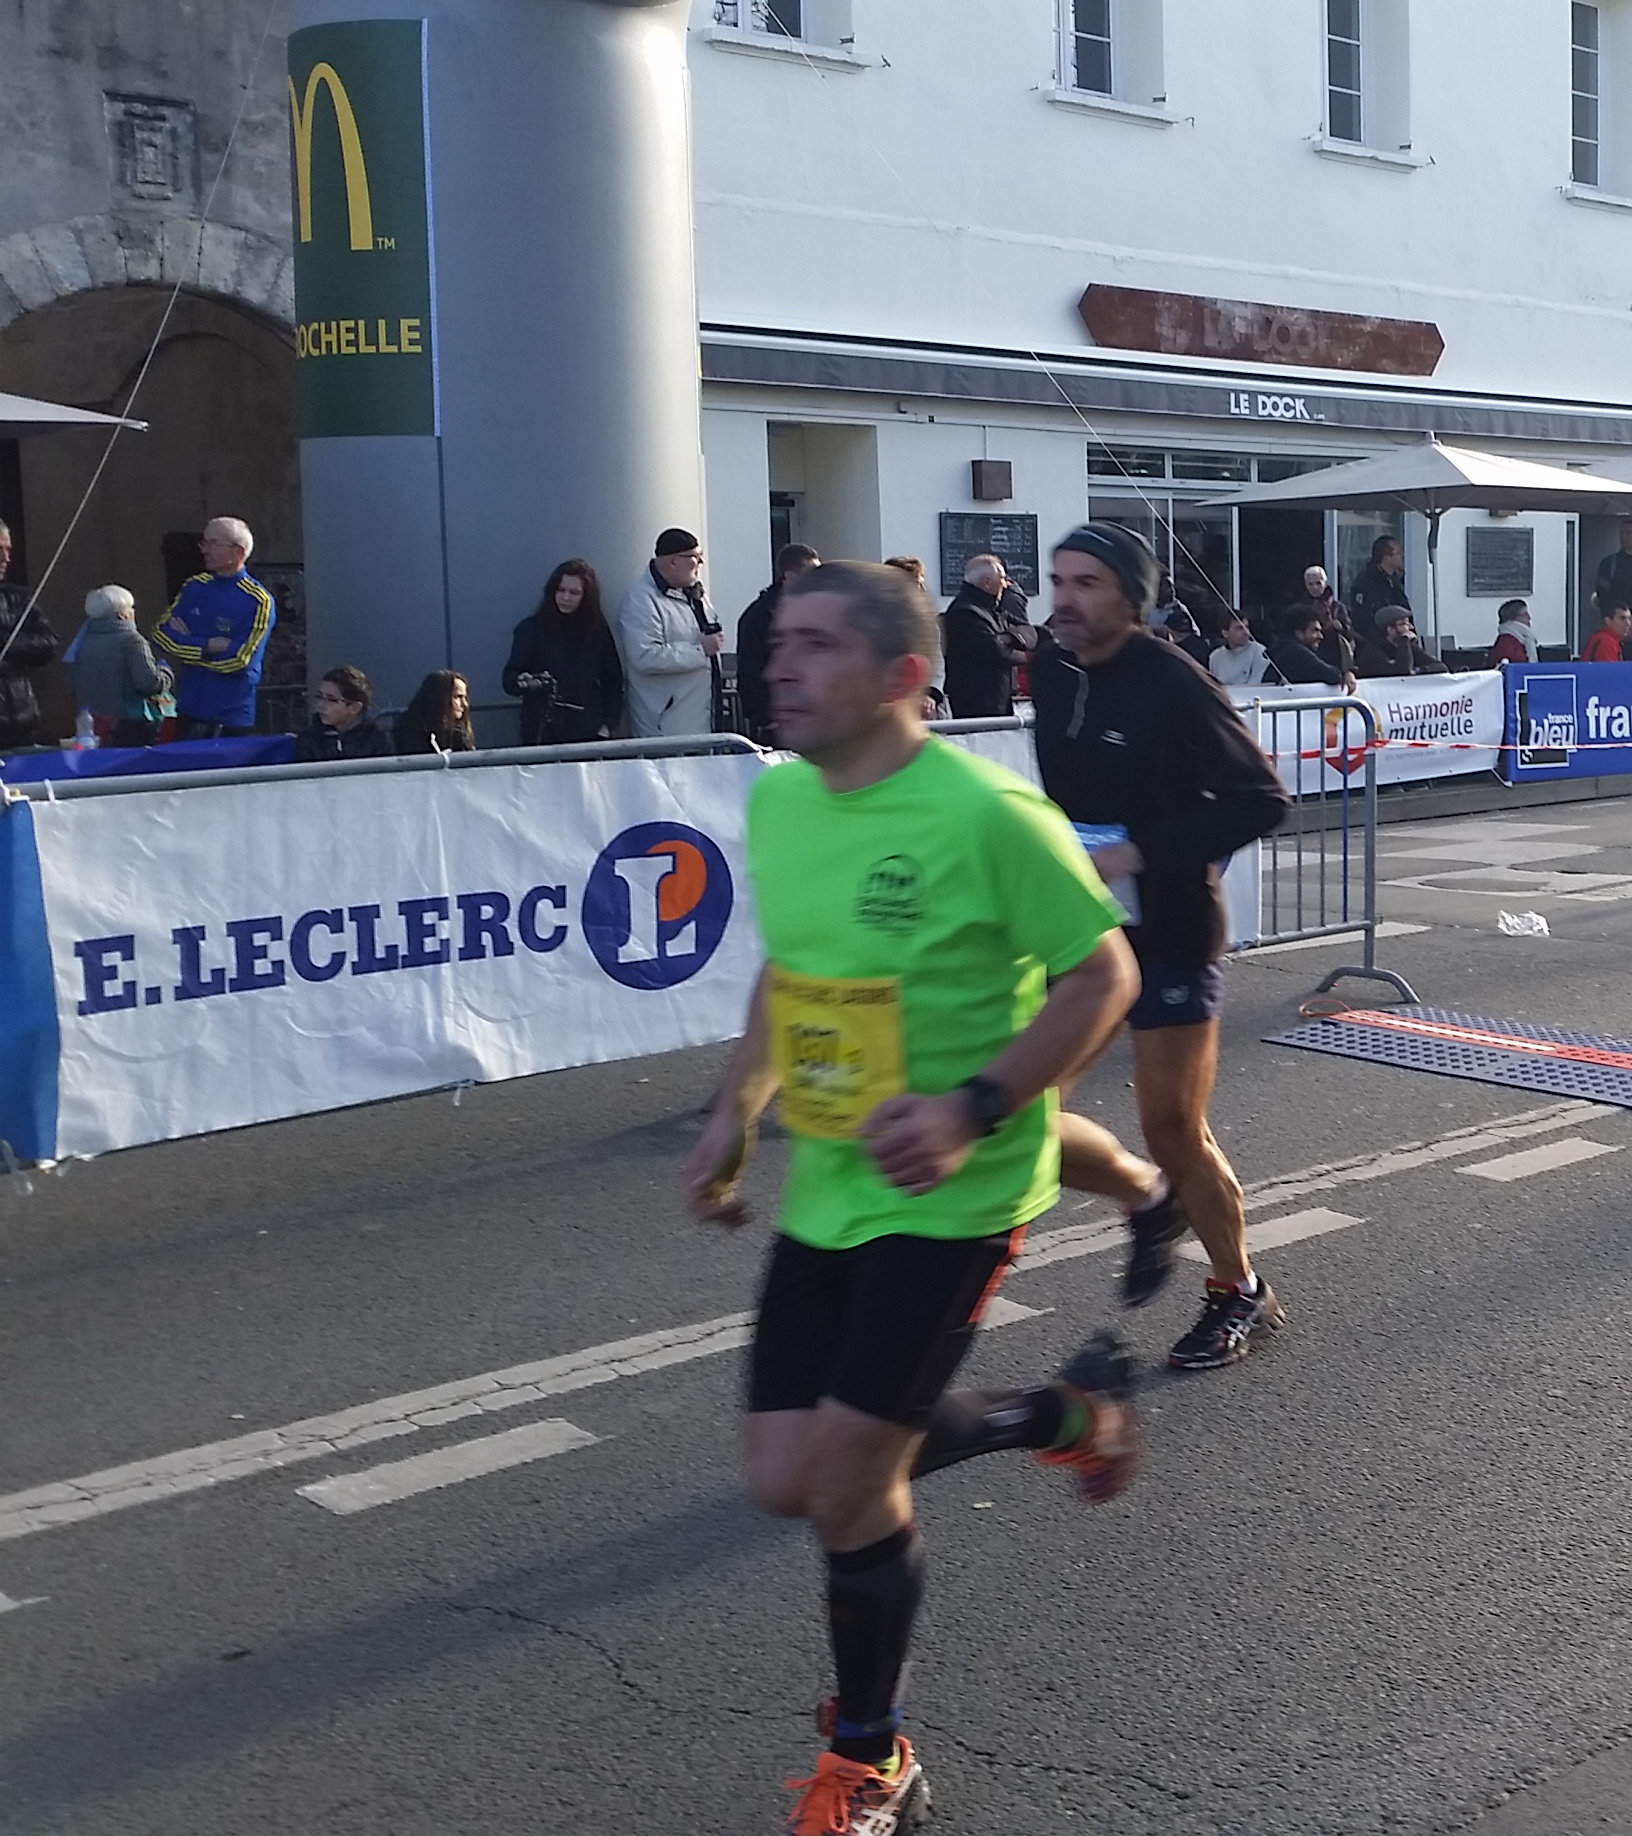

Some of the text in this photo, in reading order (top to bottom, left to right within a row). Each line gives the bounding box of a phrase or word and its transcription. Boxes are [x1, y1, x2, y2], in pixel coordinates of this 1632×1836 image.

[296, 319, 422, 358] OCHELLE
[1229, 392, 1310, 419] LE DOCK
[1387, 695, 1473, 723] Harmonie
[1548, 713, 1574, 725] france
[1389, 717, 1474, 742] mutuelle
[1530, 718, 1575, 748] bleu
